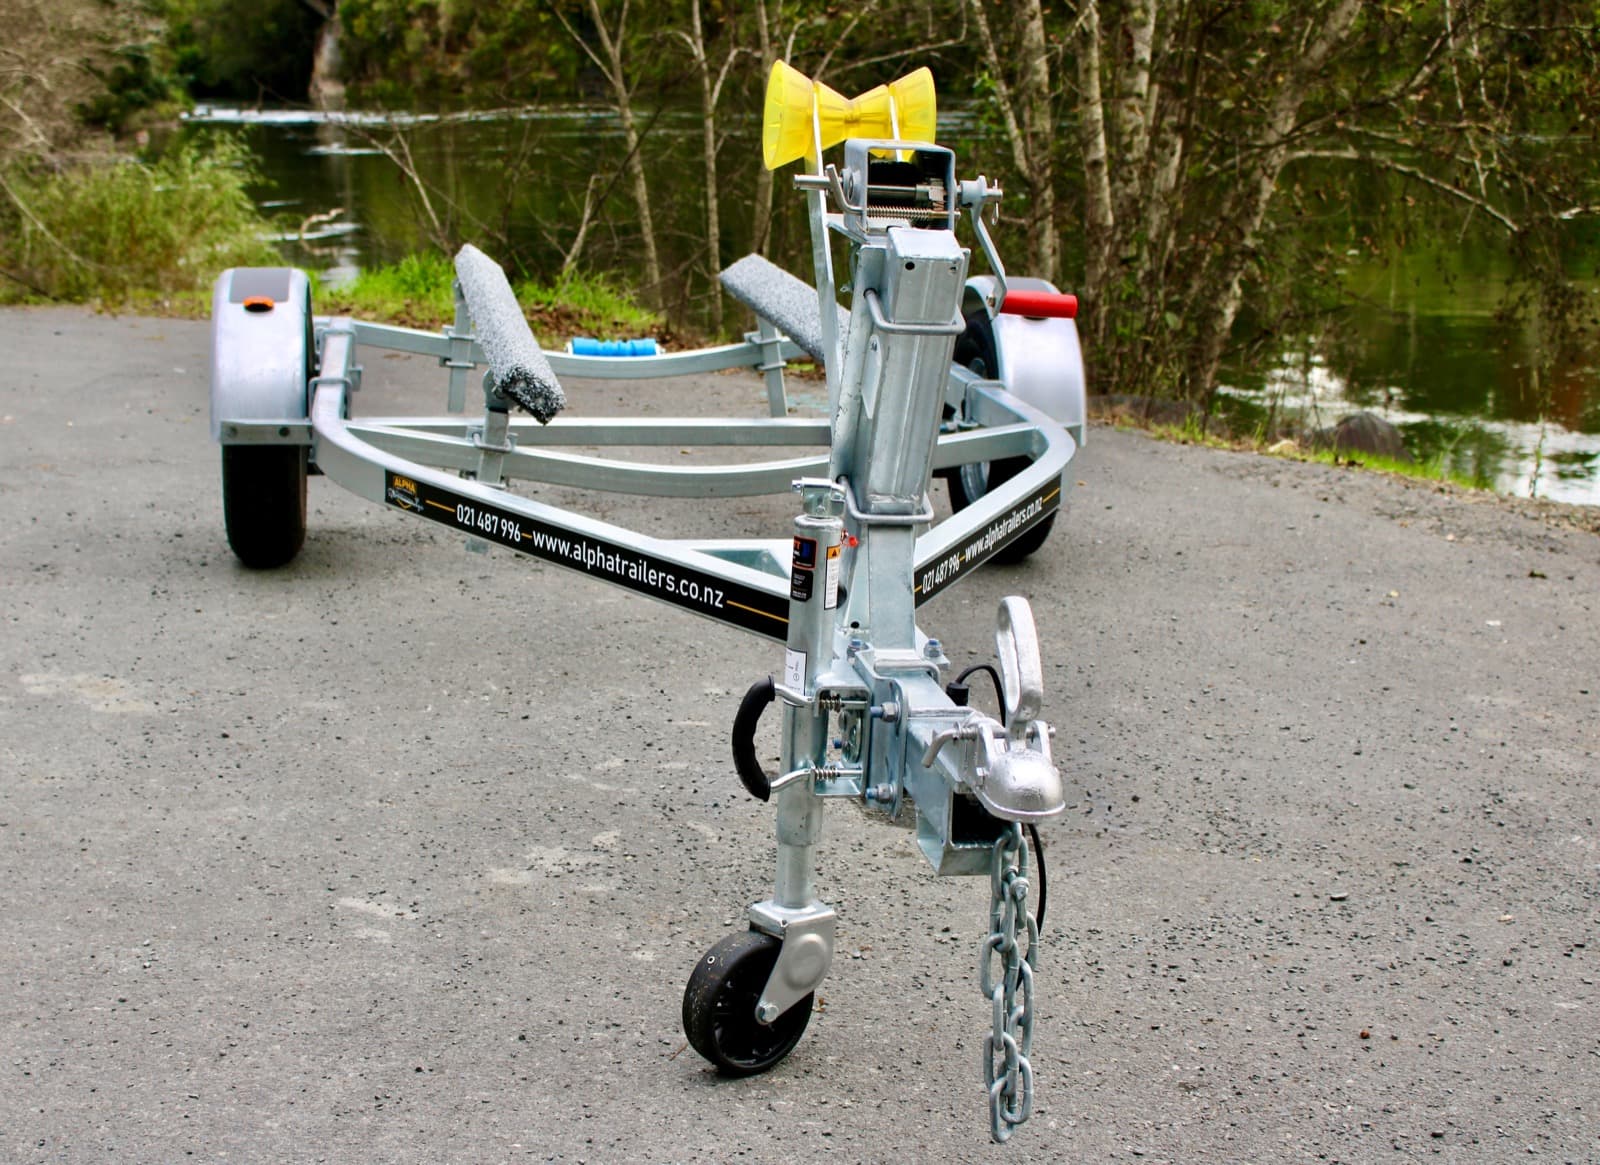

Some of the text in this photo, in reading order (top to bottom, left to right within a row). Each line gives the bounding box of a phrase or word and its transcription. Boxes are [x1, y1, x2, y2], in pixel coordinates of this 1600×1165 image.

[393, 476, 416, 494] ALPHA
[457, 504, 725, 608] 021 487 996 www.alphatrailers.co.nz
[922, 496, 1043, 594] 021 487 996 www.alphatrailers.co.nz
